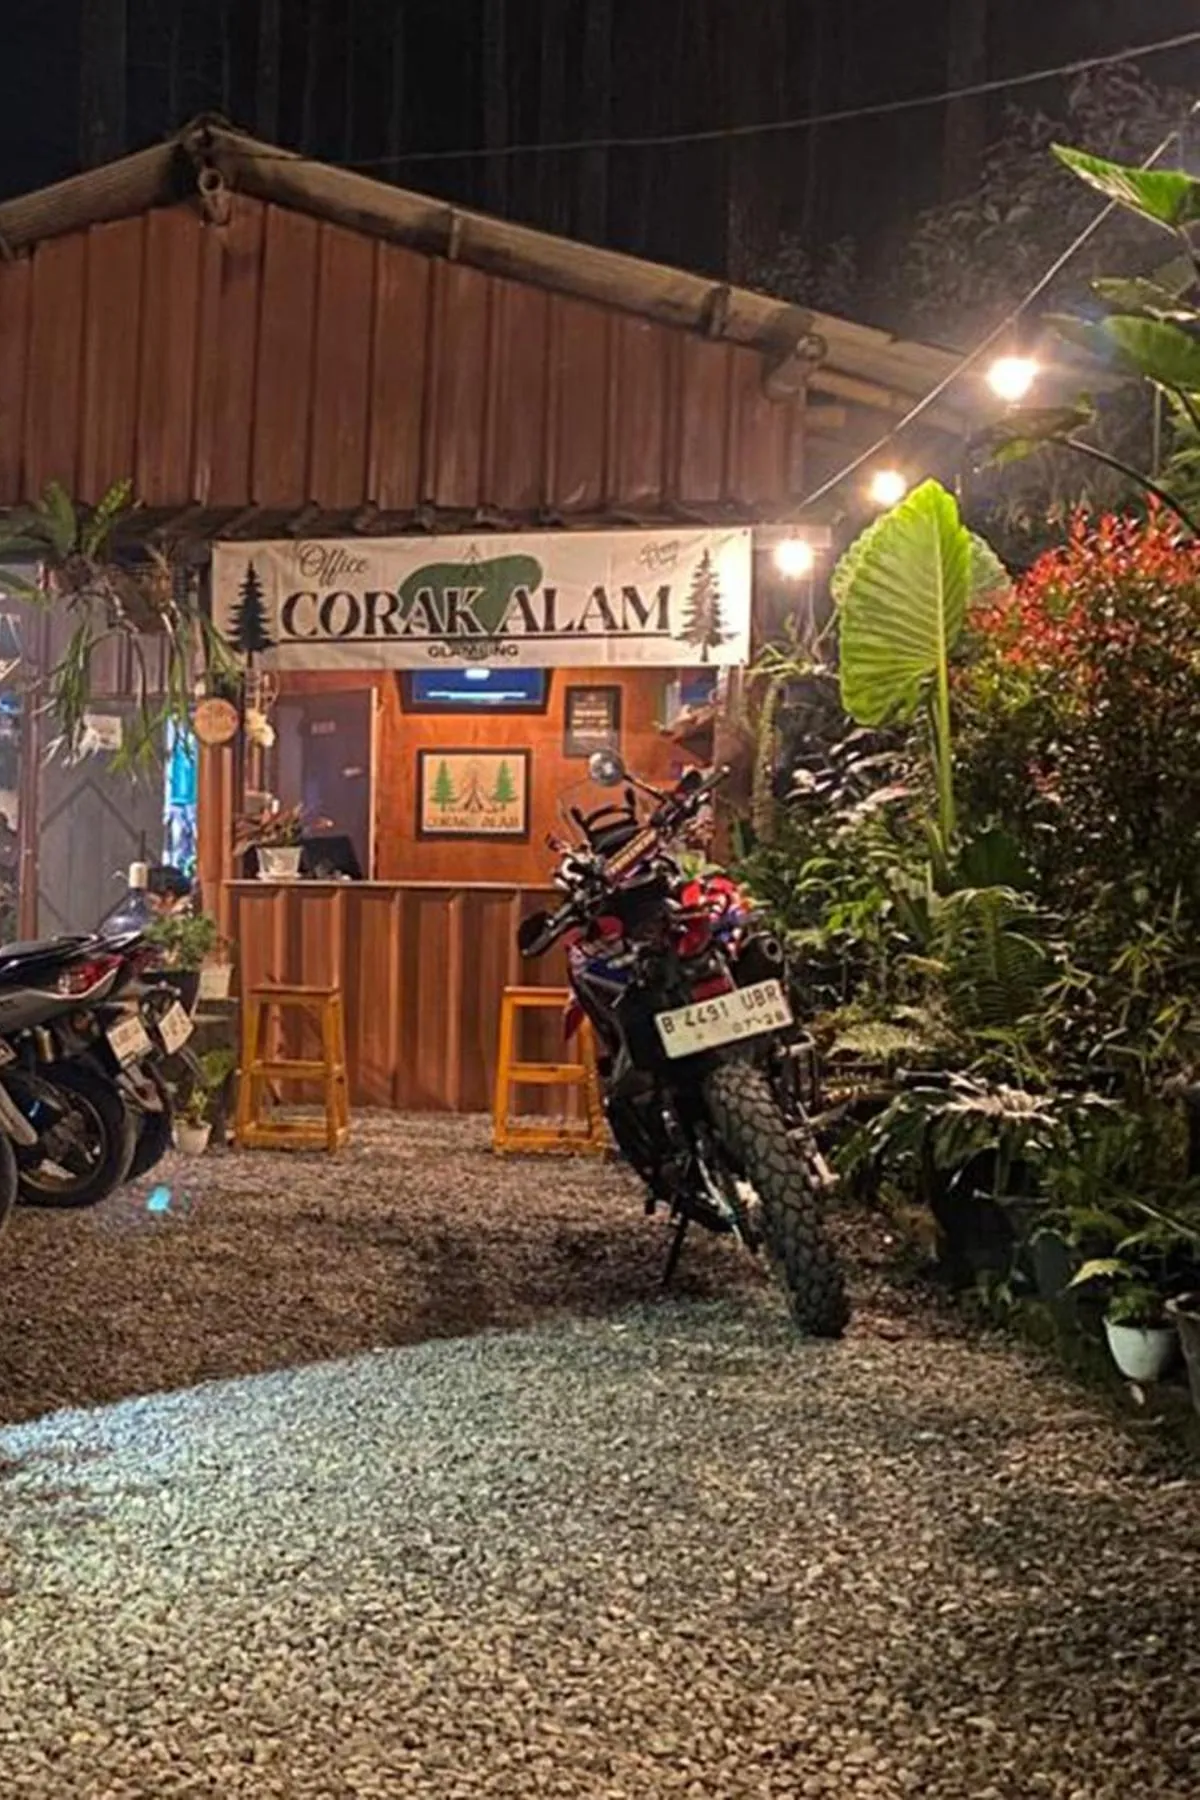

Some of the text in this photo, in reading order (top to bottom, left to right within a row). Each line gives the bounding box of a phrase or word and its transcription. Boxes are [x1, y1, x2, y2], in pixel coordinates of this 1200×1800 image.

[300, 543, 369, 587] Office
[281, 585, 670, 637] CORAK ALAM
[661, 1015, 675, 1035] B
[740, 984, 781, 1011] UBR
